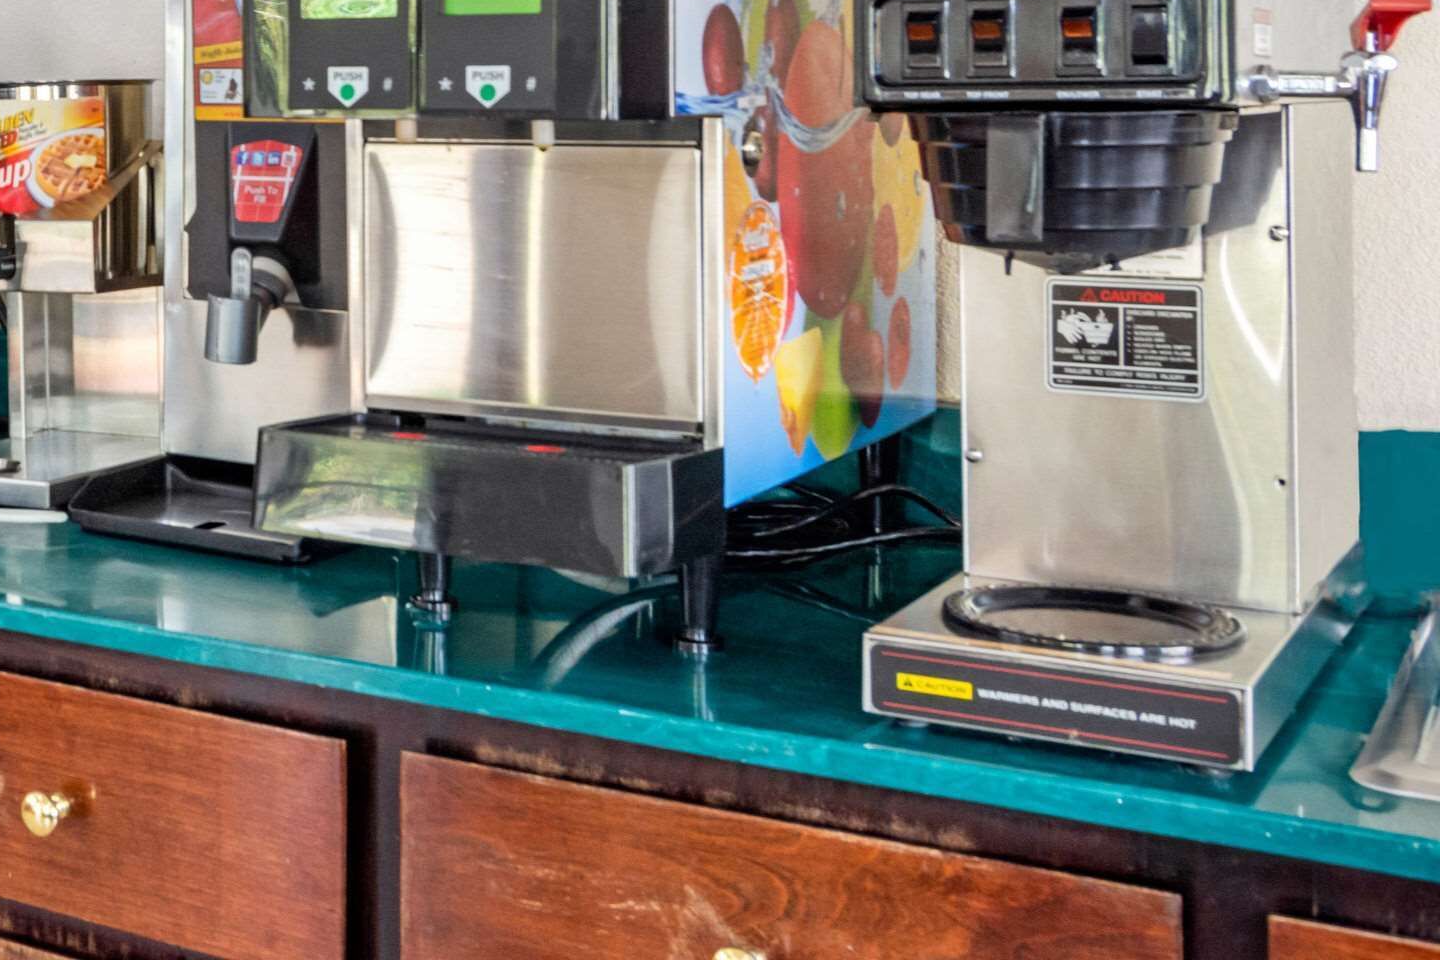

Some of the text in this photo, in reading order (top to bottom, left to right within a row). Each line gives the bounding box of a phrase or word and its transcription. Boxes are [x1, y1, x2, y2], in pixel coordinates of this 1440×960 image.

[333, 72, 363, 81] PUSH
[472, 71, 506, 81] PUSH
[1099, 290, 1166, 305] CAUTION
[977, 688, 1040, 706] WARMERS
[1041, 697, 1069, 711] AND
[1070, 701, 1137, 721] SURFACES
[1139, 711, 1167, 726] ARE
[1168, 716, 1198, 730] HOT
